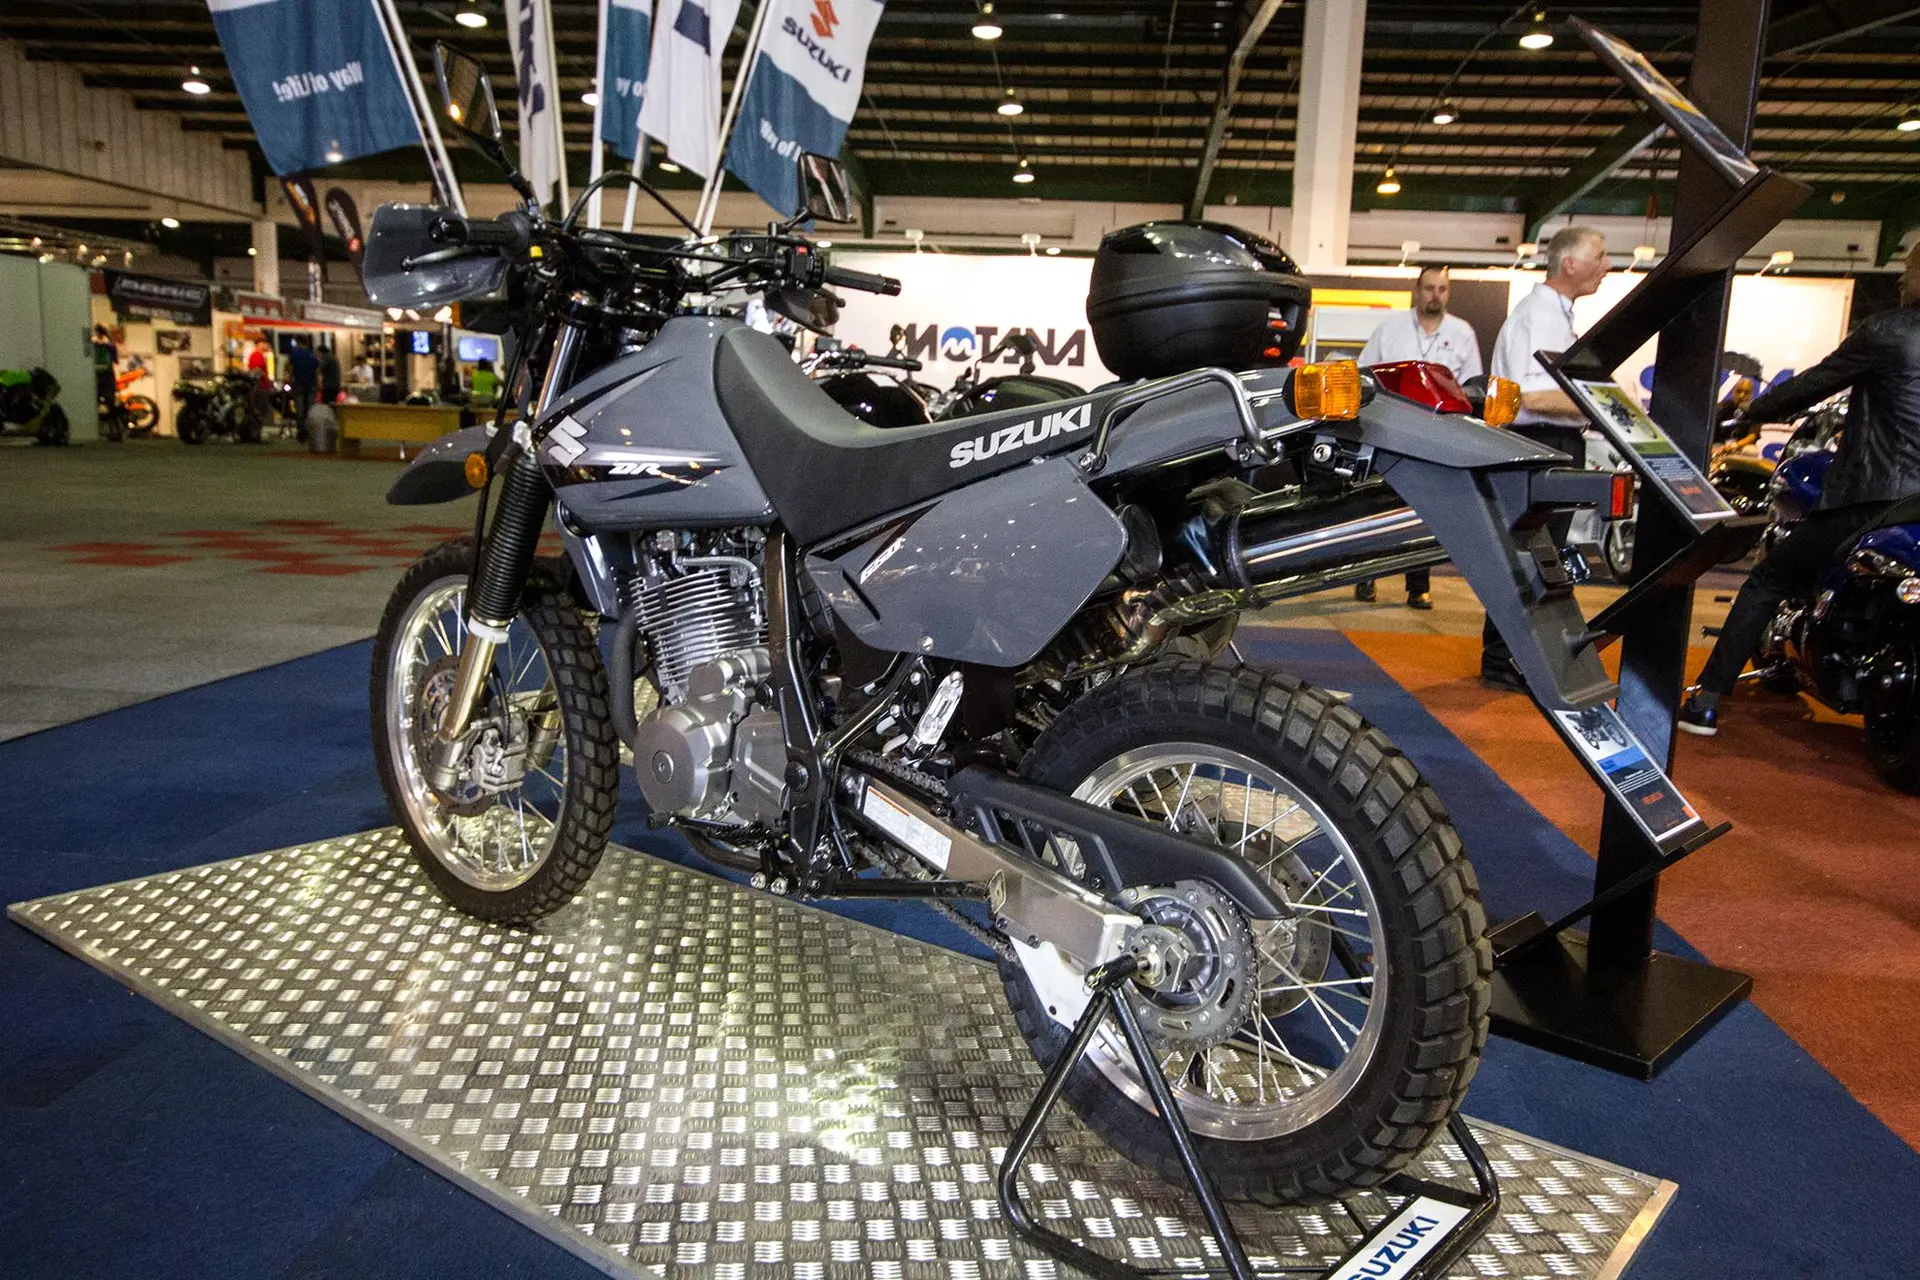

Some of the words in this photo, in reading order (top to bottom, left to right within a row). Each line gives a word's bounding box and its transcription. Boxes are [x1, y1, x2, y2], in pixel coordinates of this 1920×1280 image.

[781, 16, 852, 84] SUZUKI
[608, 462, 662, 476] DR
[949, 402, 1092, 469] SUZUKI
